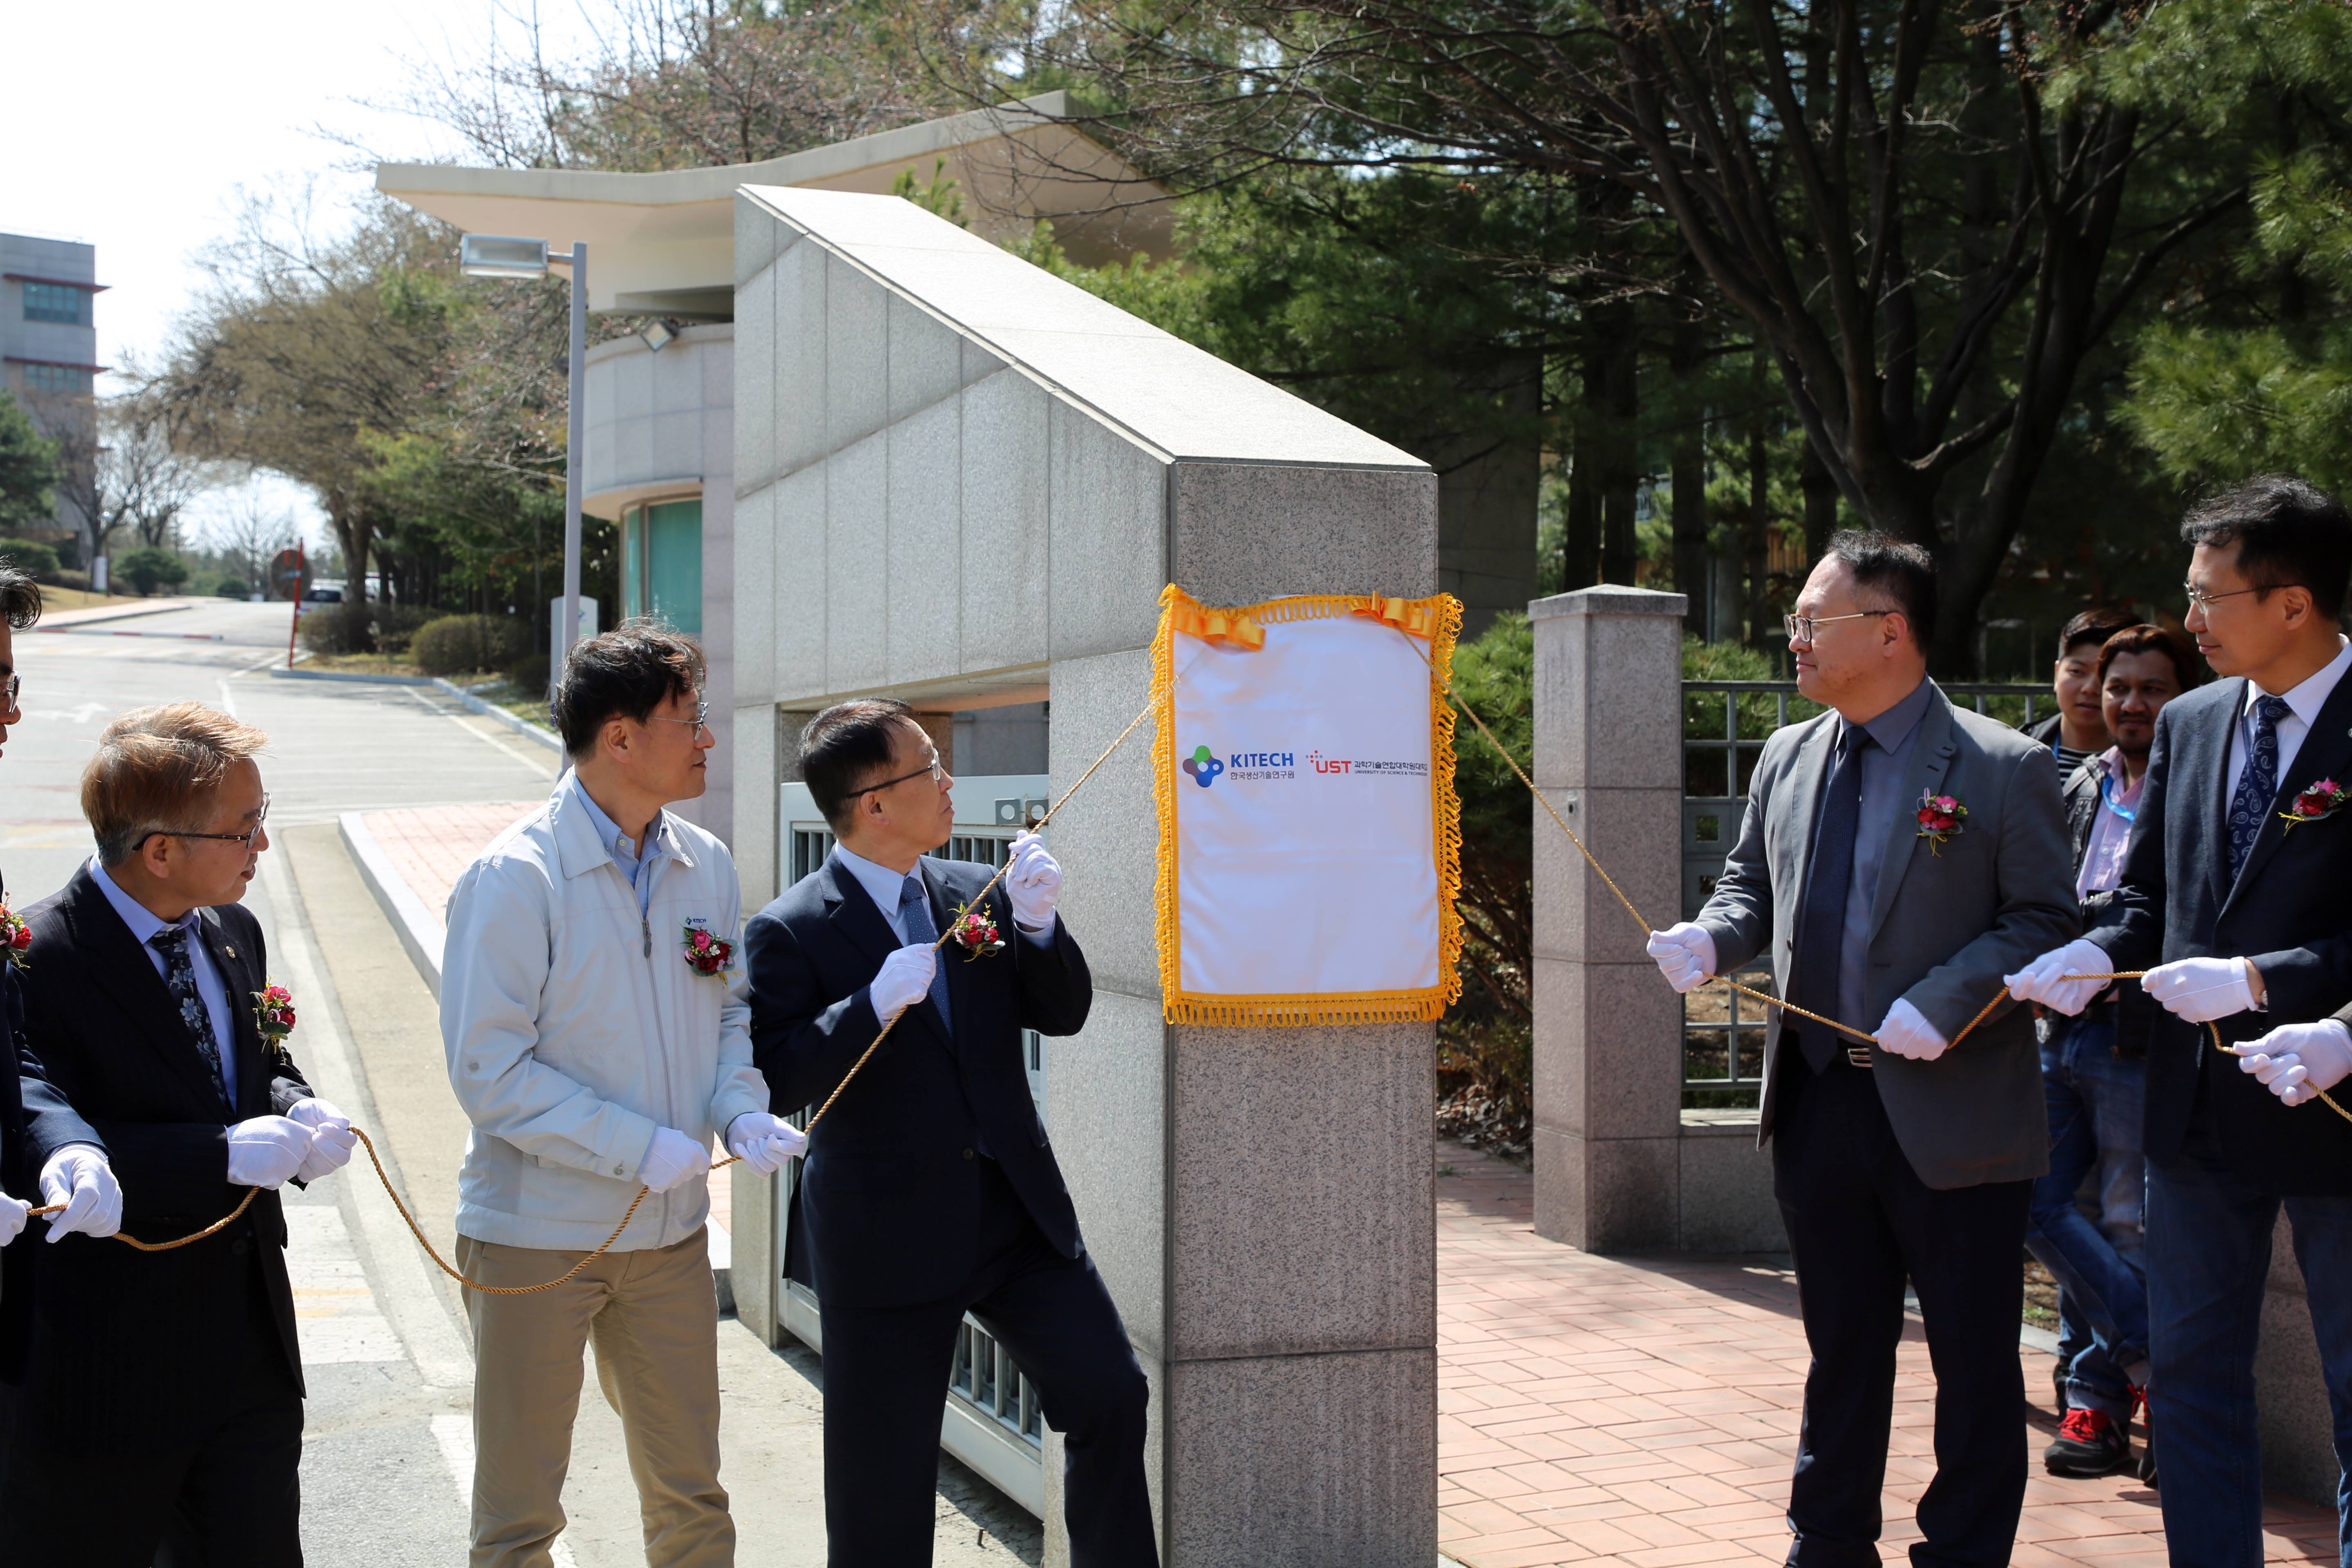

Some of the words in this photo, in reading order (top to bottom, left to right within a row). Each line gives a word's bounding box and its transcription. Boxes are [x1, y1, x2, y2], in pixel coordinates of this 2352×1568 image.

[1231, 753, 1294, 768] KITECH
[1316, 760, 1352, 773] UST
[1230, 771, 1294, 780] 한국생산기술연구원
